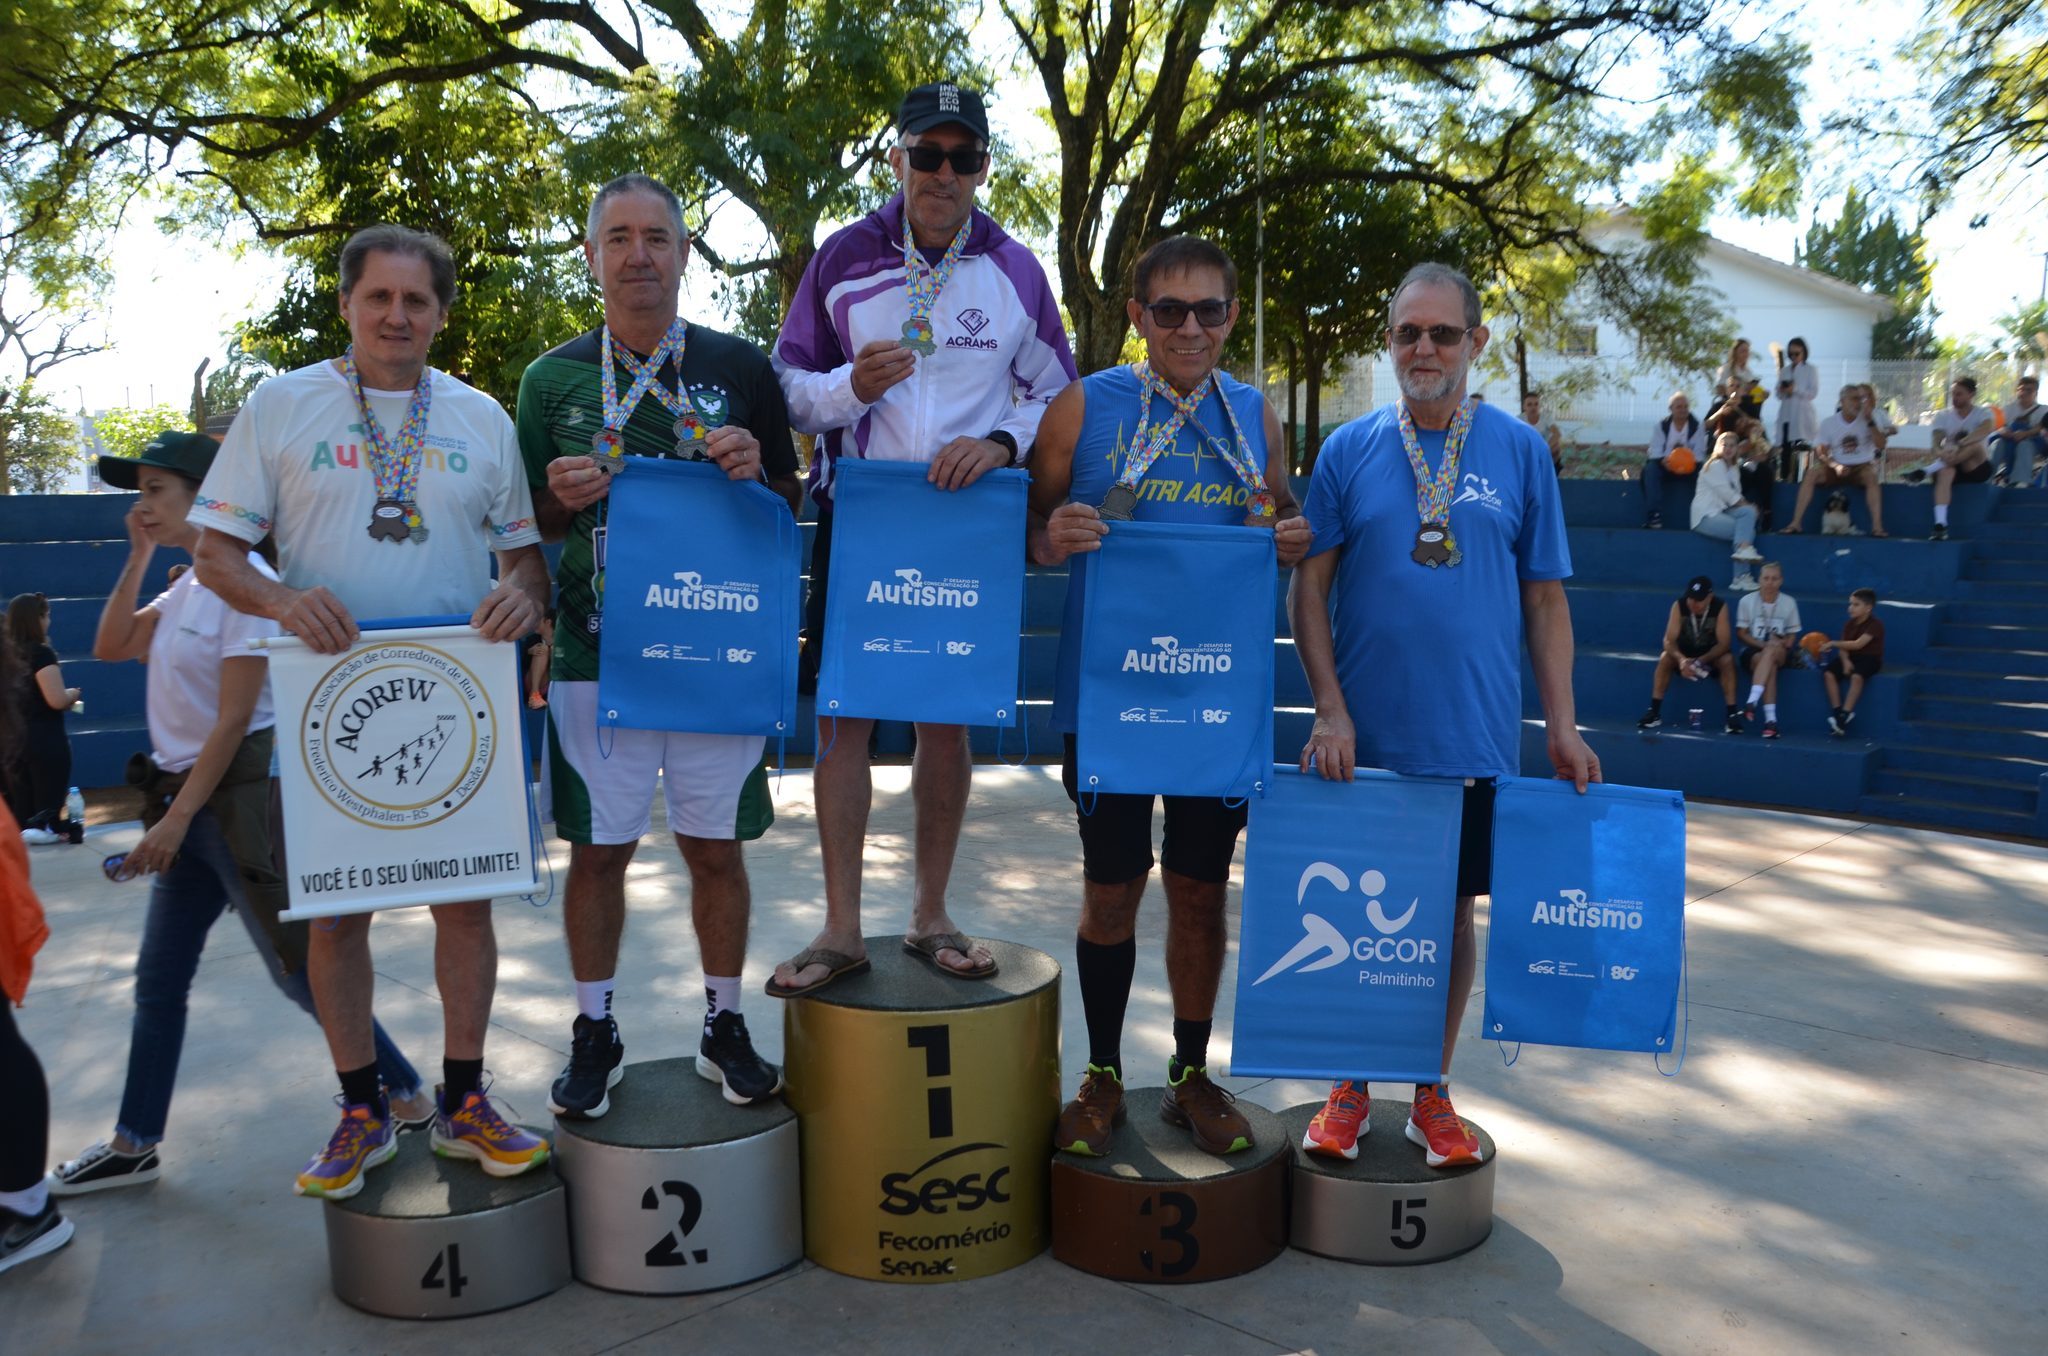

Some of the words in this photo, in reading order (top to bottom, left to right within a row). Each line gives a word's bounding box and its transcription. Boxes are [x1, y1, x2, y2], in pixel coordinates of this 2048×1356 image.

[945, 336, 998, 349] ACRAMS
[1183, 481, 1250, 508] AÇÃO
[644, 584, 759, 612] Autismo
[866, 580, 979, 608] Autismo
[365, 652, 379, 665] de
[380, 648, 448, 670] Corredores
[447, 665, 463, 681] de
[458, 677, 477, 701] Rua
[1122, 649, 1232, 674] Autismo
[335, 677, 438, 754] ACORFW
[309, 738, 338, 793] Frederico
[456, 766, 483, 799] Desde
[478, 735, 491, 767] 2024
[301, 867, 344, 894] VOCÊ
[349, 866, 358, 889] É
[362, 868, 372, 887] O
[376, 864, 407, 886] SEU
[412, 858, 459, 882] ÚNICO
[463, 852, 520, 876] LIMITE!
[1531, 901, 1643, 930] Autismo
[1353, 936, 1437, 964] GCOR
[1359, 971, 1435, 988] Palmitinho
[907, 1024, 953, 1139] 1
[879, 1143, 1010, 1215] Sesc
[641, 1180, 708, 1267] 2
[879, 1221, 1011, 1251] Fecomércio
[1138, 1191, 1200, 1278] 3
[1390, 1197, 1427, 1250] 5
[420, 1243, 468, 1298] 4
[880, 1257, 954, 1276] Senac
